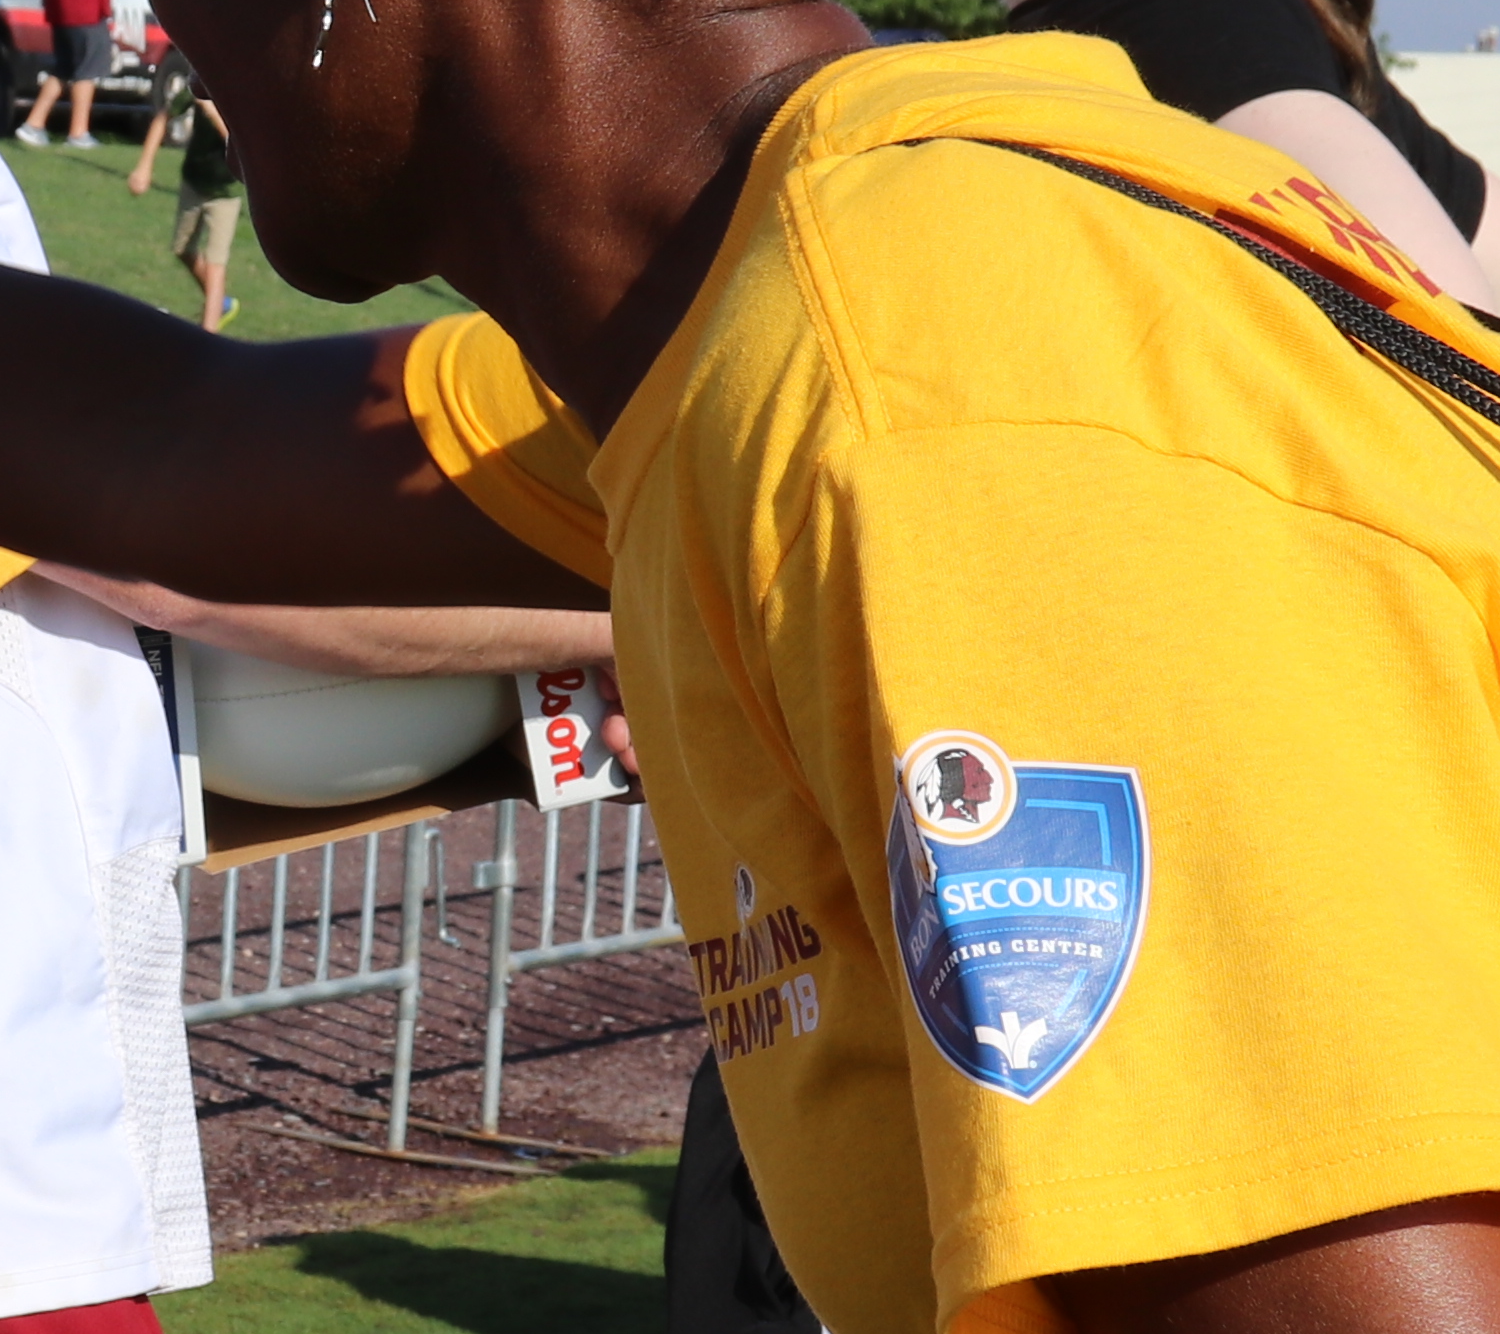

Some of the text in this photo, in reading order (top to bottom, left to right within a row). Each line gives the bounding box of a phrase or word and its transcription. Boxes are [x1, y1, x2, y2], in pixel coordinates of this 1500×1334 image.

[688, 904, 822, 999] TRAINING
[909, 876, 1119, 967] BON SECOURS
[928, 938, 1104, 1000] TRAINING CENTER
[708, 972, 820, 1064] CAMP 18
